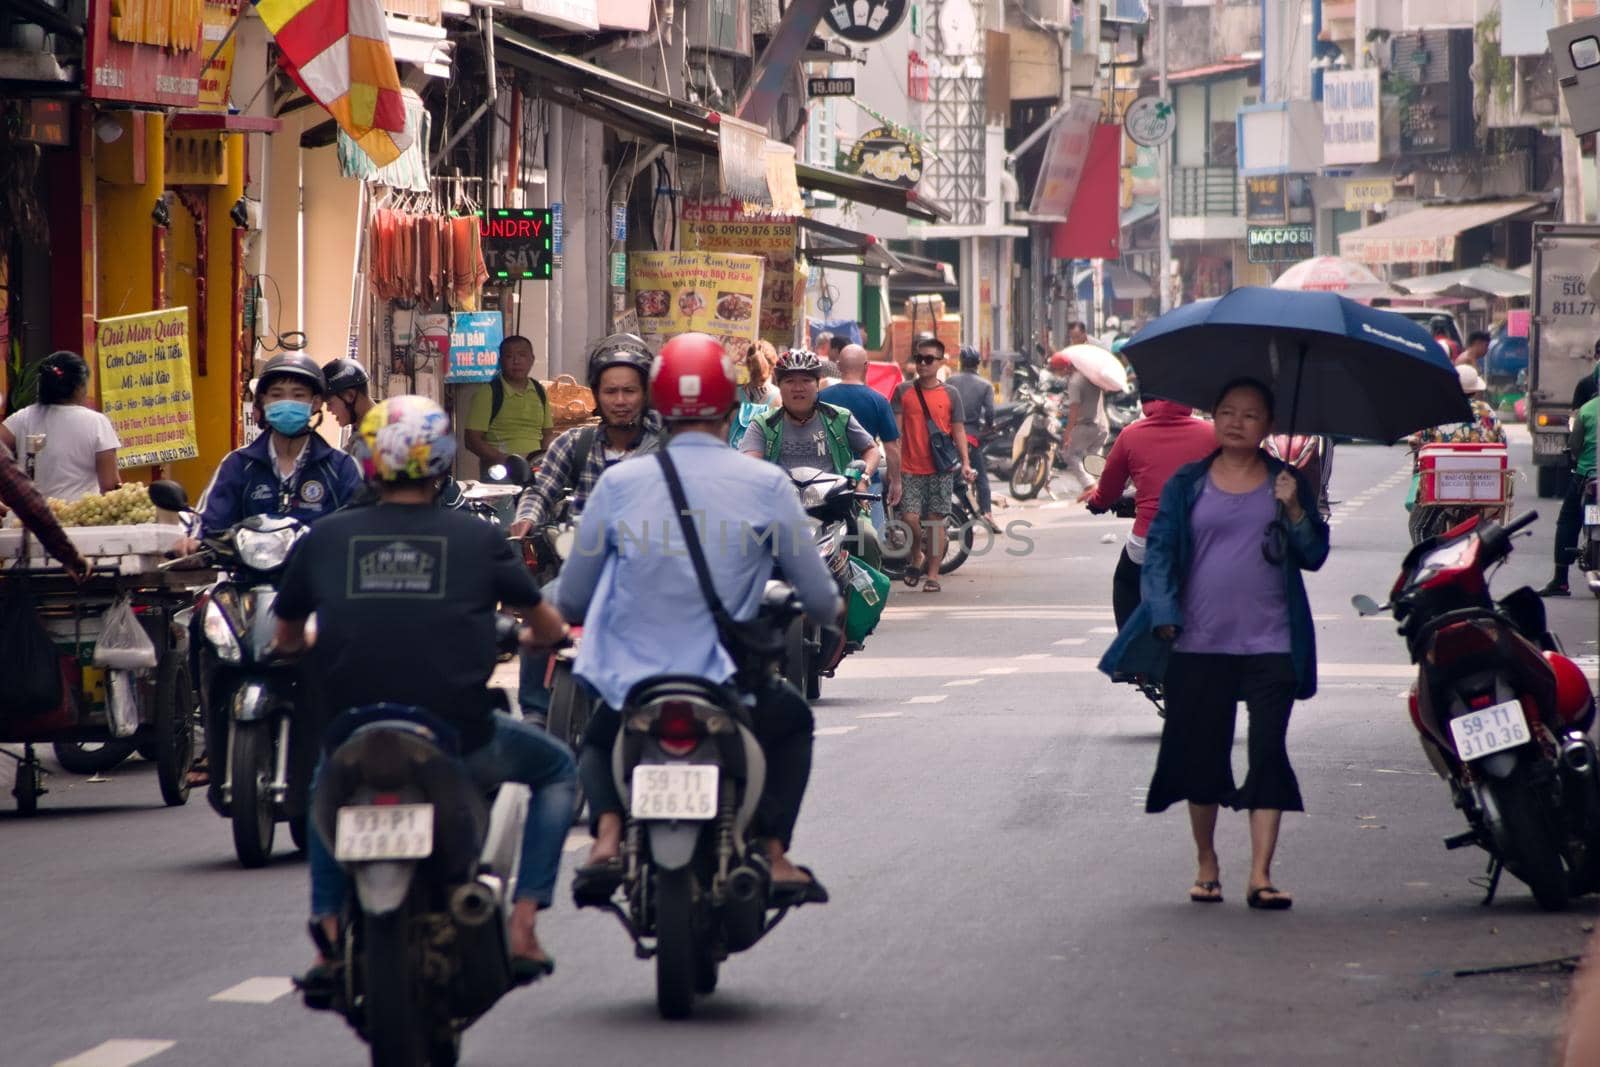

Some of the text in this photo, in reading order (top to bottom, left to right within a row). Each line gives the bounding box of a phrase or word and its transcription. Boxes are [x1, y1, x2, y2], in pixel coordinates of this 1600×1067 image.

[812, 81, 852, 93] 15.000
[721, 225, 749, 236] 0909
[752, 225, 770, 236] 876
[773, 226, 792, 236] 558
[1250, 229, 1273, 245] BAO
[1274, 229, 1298, 244] CAO
[1562, 281, 1586, 297] 51C
[1461, 706, 1511, 737] 59-T1
[1462, 723, 1524, 756] 310.36
